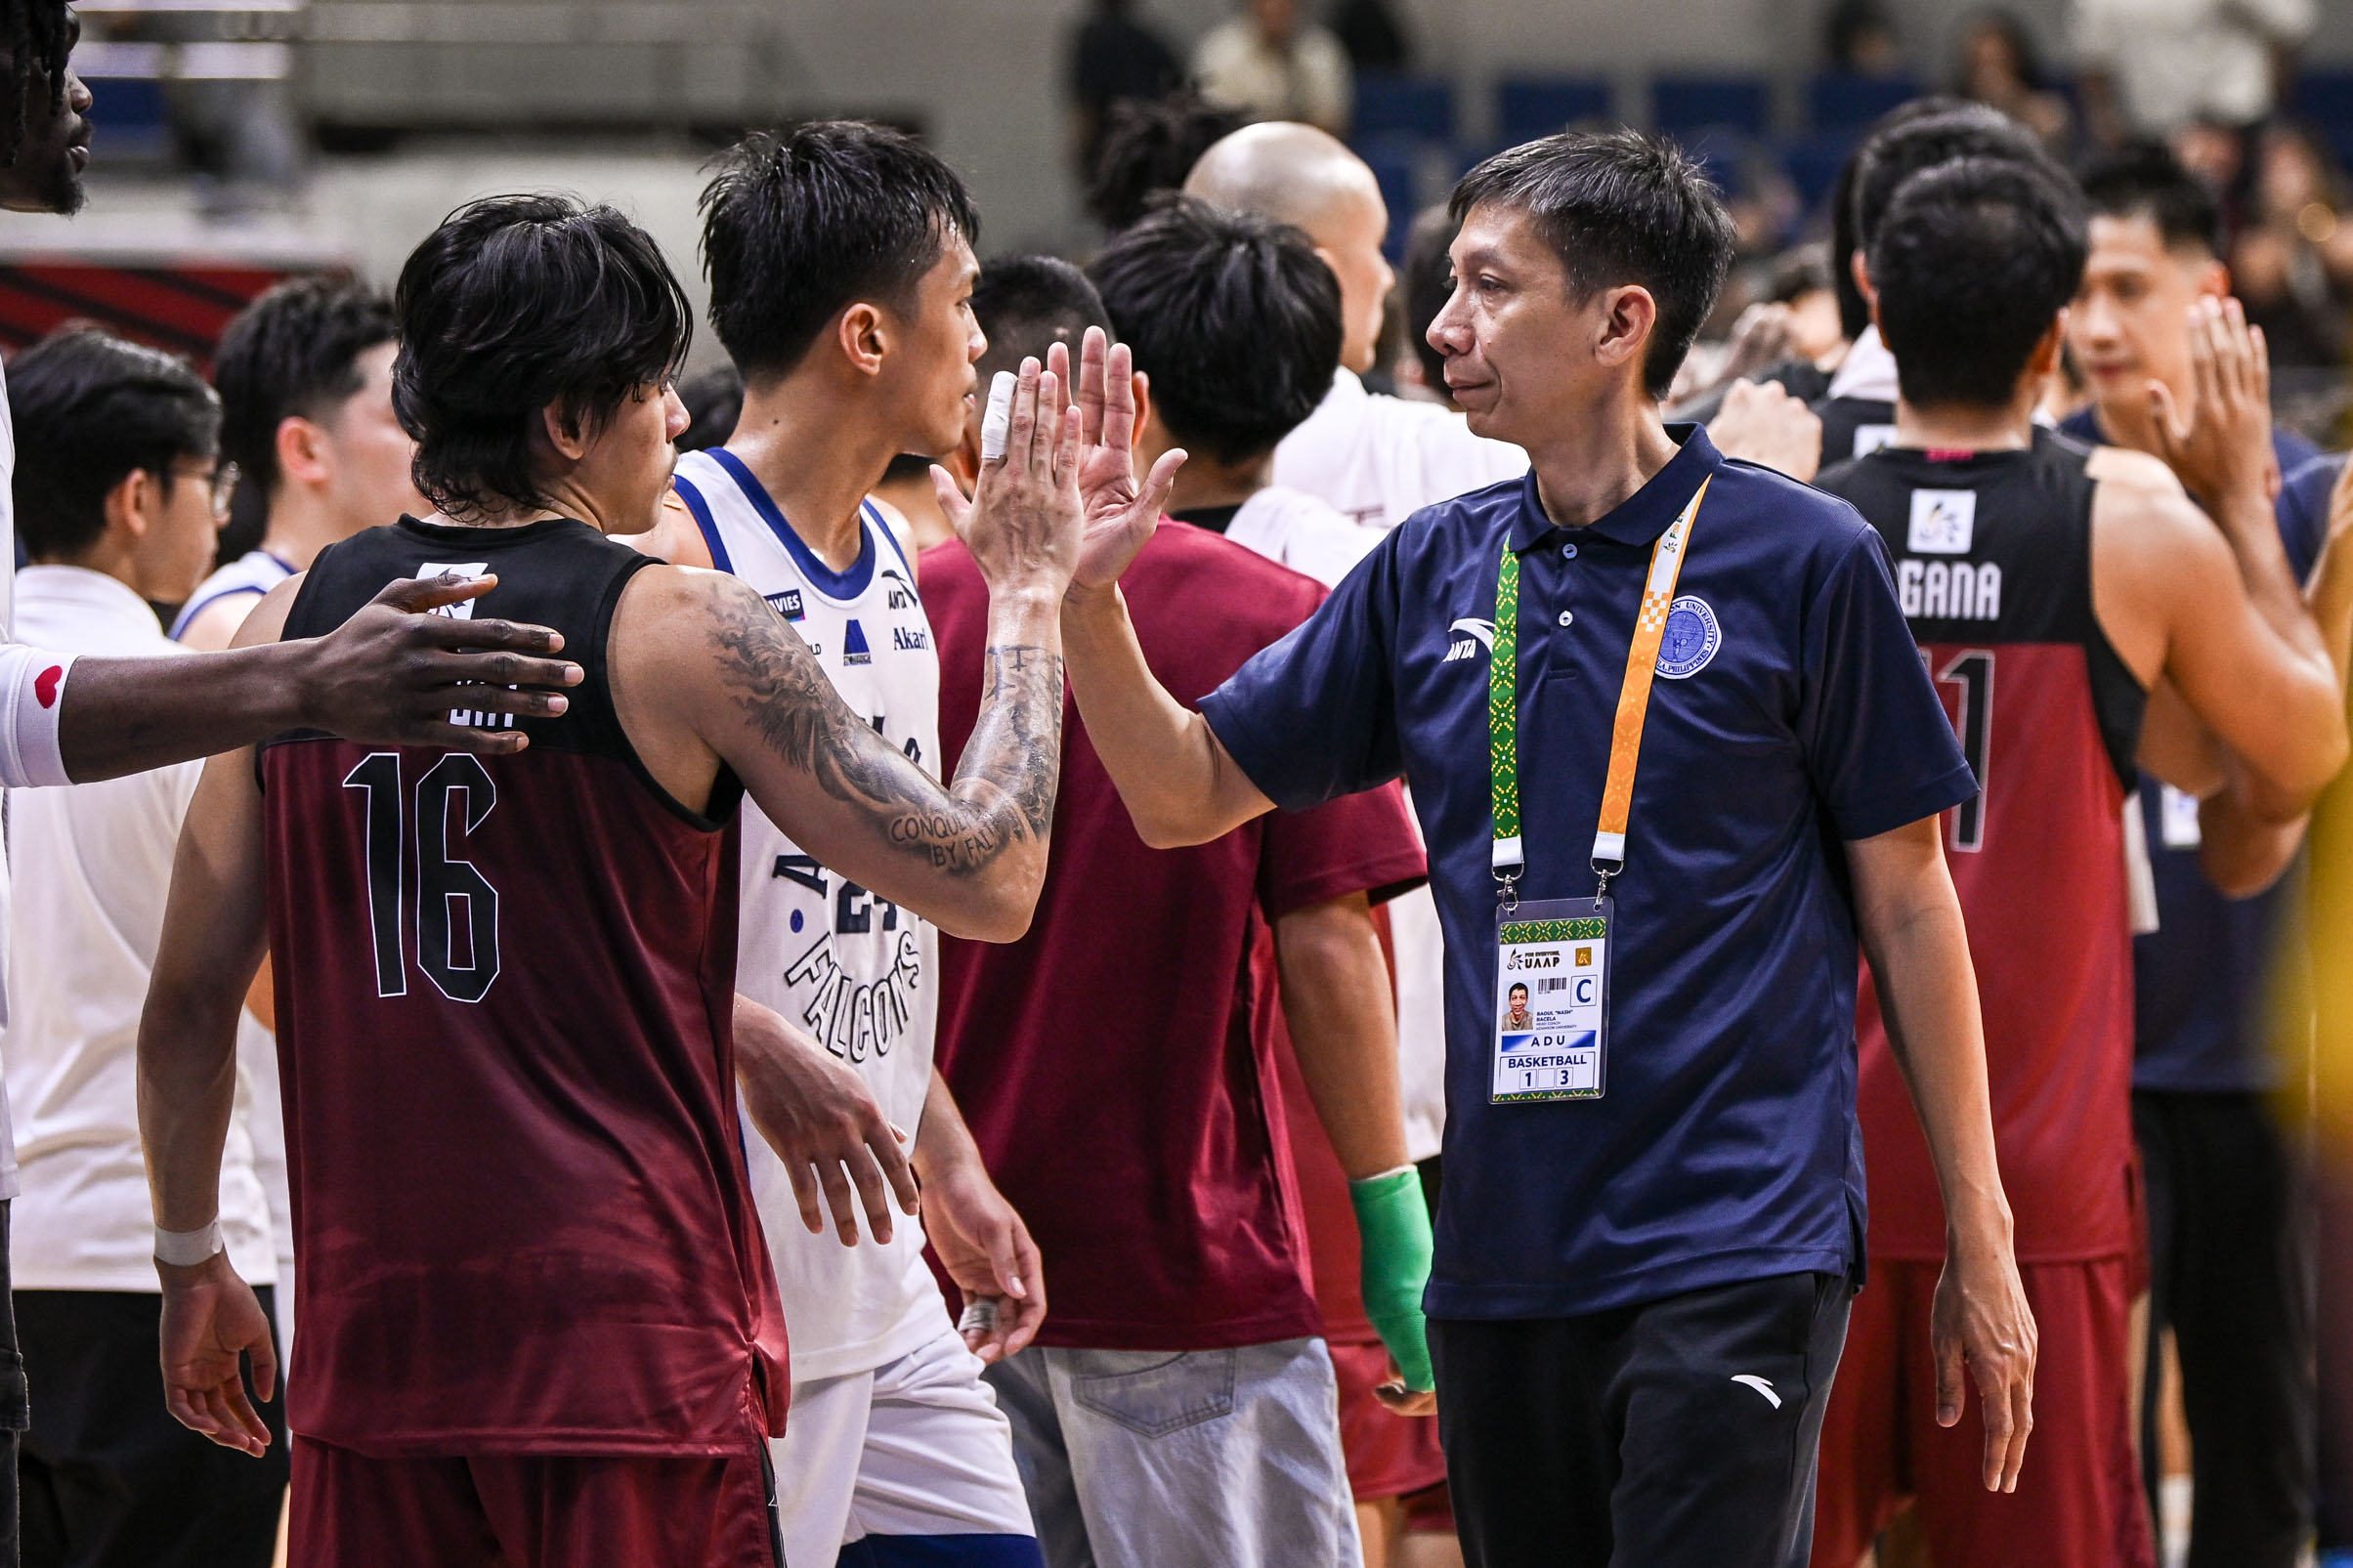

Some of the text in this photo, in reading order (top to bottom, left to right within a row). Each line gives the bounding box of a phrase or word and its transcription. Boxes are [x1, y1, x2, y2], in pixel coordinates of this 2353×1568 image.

[1686, 602, 1715, 647] UNIVERSITY
[1442, 638, 1476, 662] ANTA
[932, 841, 957, 868] BY
[342, 752, 500, 1003] 16
[1524, 956, 1561, 969] UAAP
[784, 930, 920, 1063] FALCONS
[1576, 978, 1592, 1003] C
[1508, 1054, 1587, 1069] BASKETBALL
